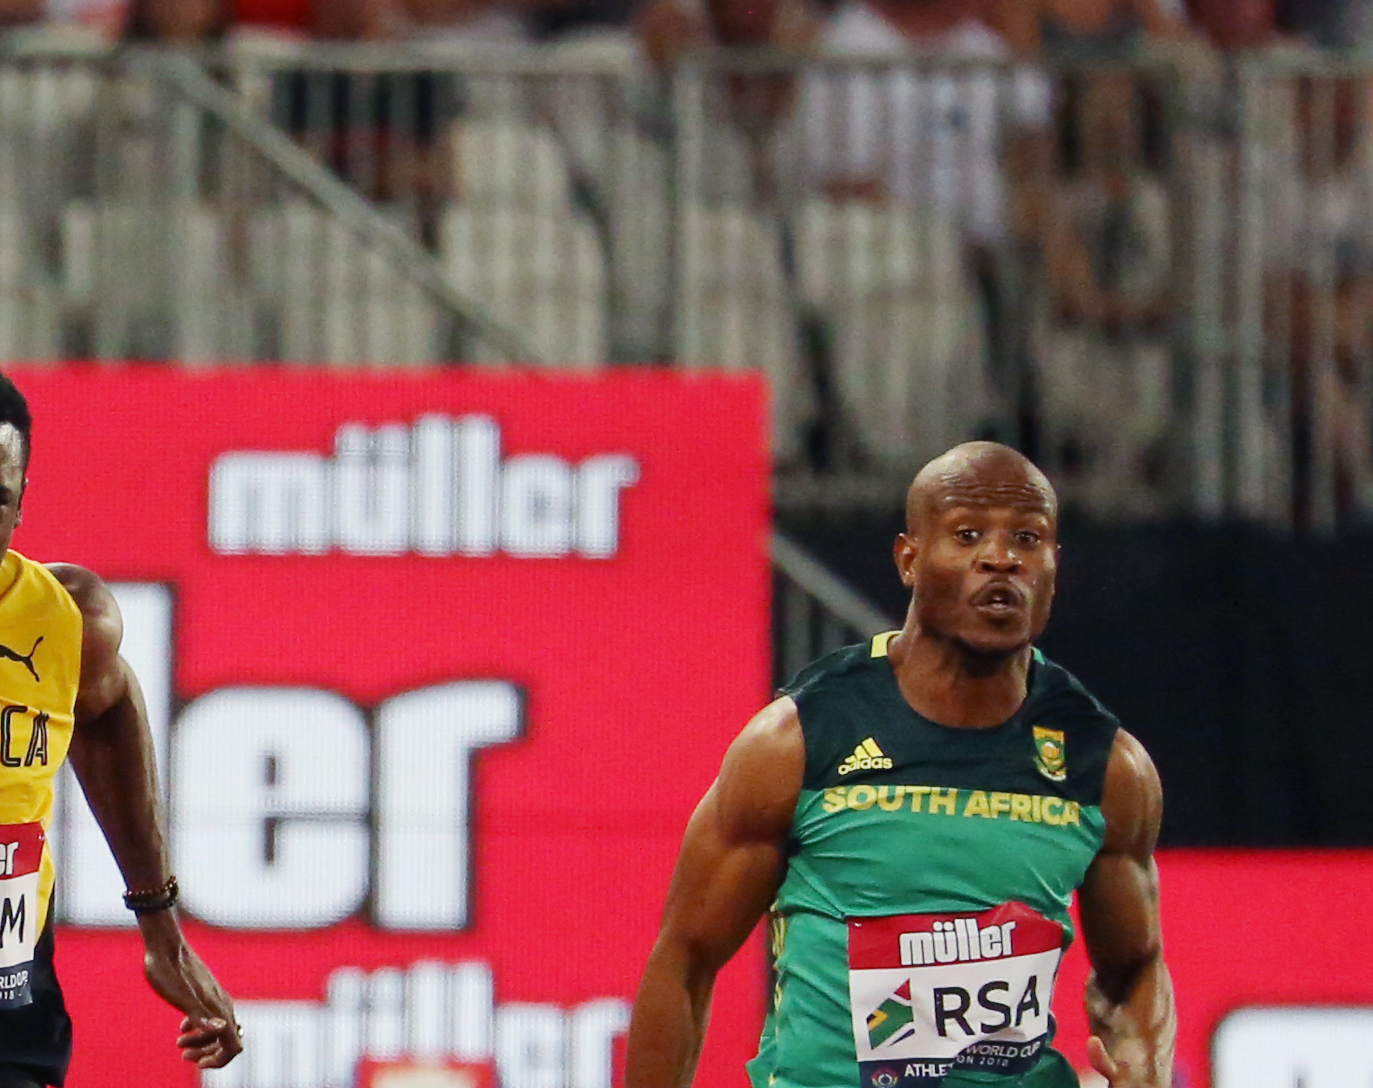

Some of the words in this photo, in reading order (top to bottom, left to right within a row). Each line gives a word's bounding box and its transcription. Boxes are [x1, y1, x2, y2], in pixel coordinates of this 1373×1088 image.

[207, 413, 641, 558] müller
[837, 755, 894, 776] adidas
[821, 784, 958, 815] SOUTH
[963, 790, 1081, 827] AFRICA
[898, 918, 1017, 966] müller
[933, 974, 1041, 1038] RSA
